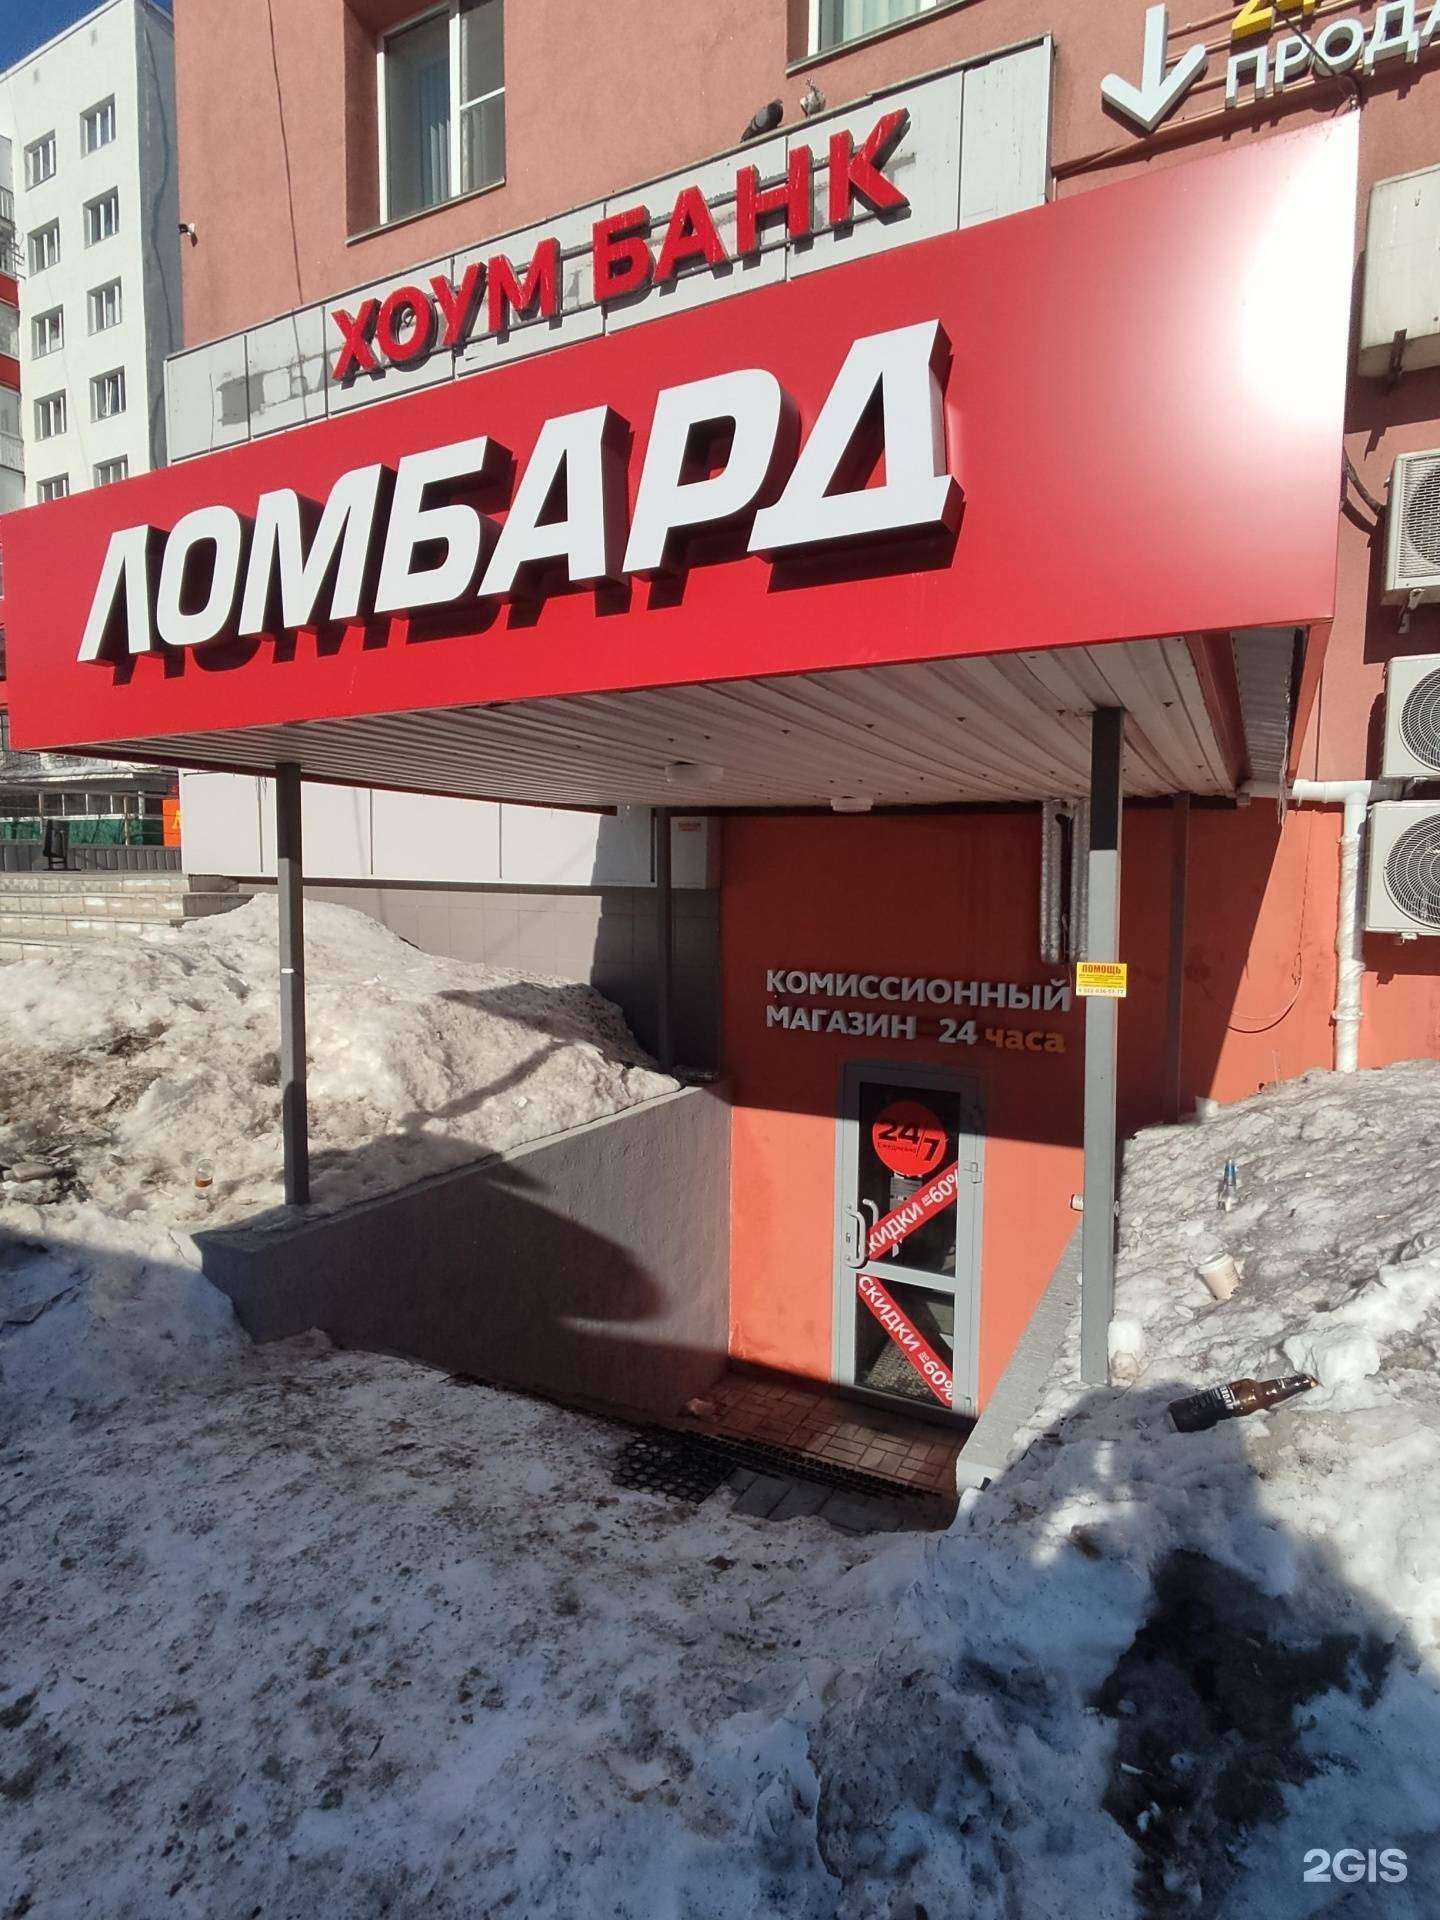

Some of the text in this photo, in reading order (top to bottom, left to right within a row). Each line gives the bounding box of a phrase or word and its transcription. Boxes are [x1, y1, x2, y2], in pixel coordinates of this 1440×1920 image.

[331, 107, 910, 381] ХОУМ БАНК
[78, 319, 956, 664] ЛОМБАРД
[766, 969, 1072, 1012] КОМИССИОННЫЙ
[1082, 965, 1121, 975] ПОМОЩЬ
[766, 1005, 1067, 1053] МАГАЗИН 24 часа
[868, 1202, 925, 1254] КИДКИ
[859, 1275, 921, 1351] СКИДКИ
